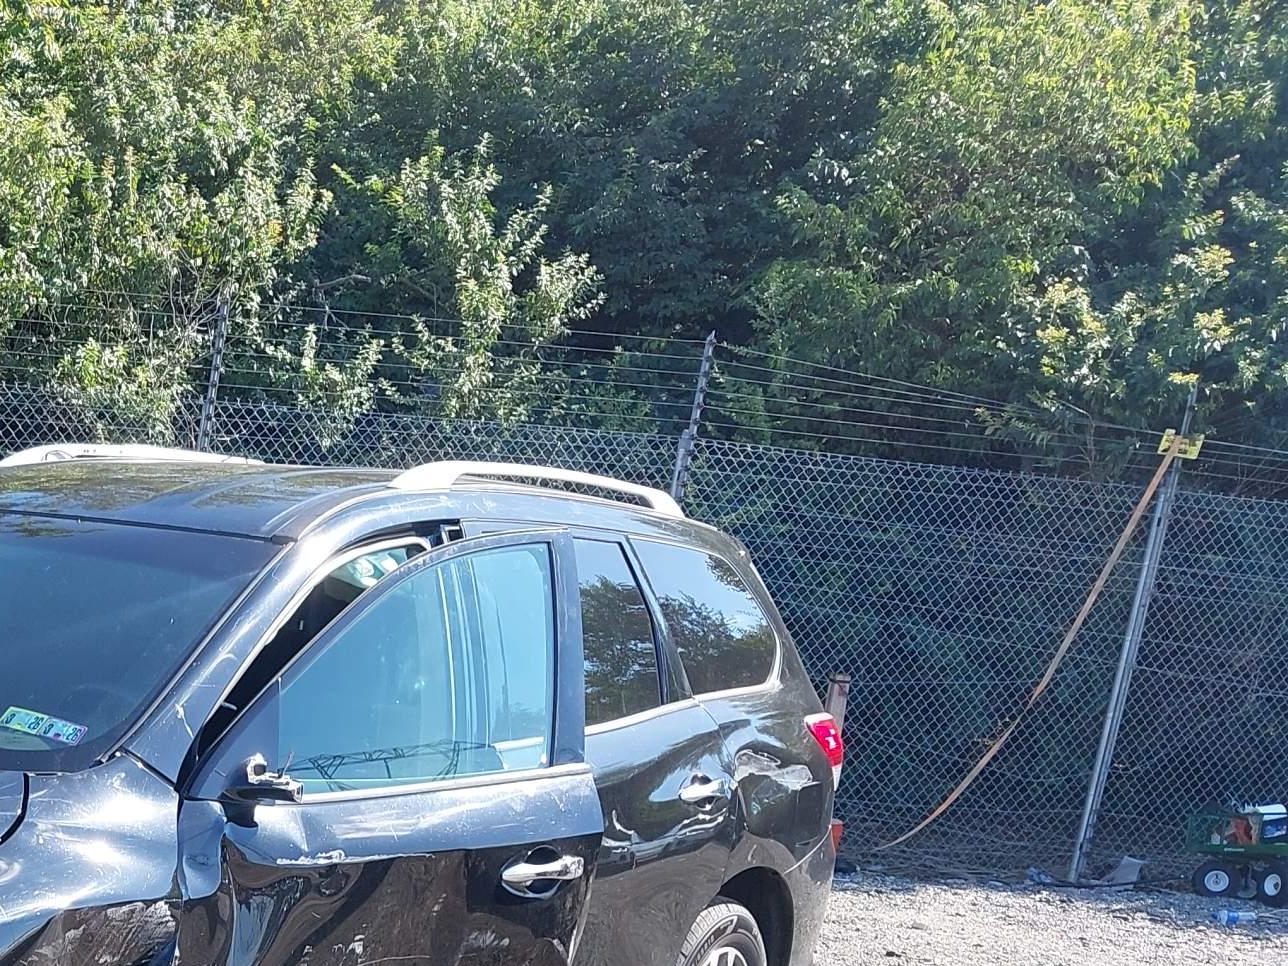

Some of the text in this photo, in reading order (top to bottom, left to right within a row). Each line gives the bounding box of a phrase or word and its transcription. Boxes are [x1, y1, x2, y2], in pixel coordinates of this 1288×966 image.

[5, 713, 45, 731] 3 26
[43, 723, 82, 742] 3 26
